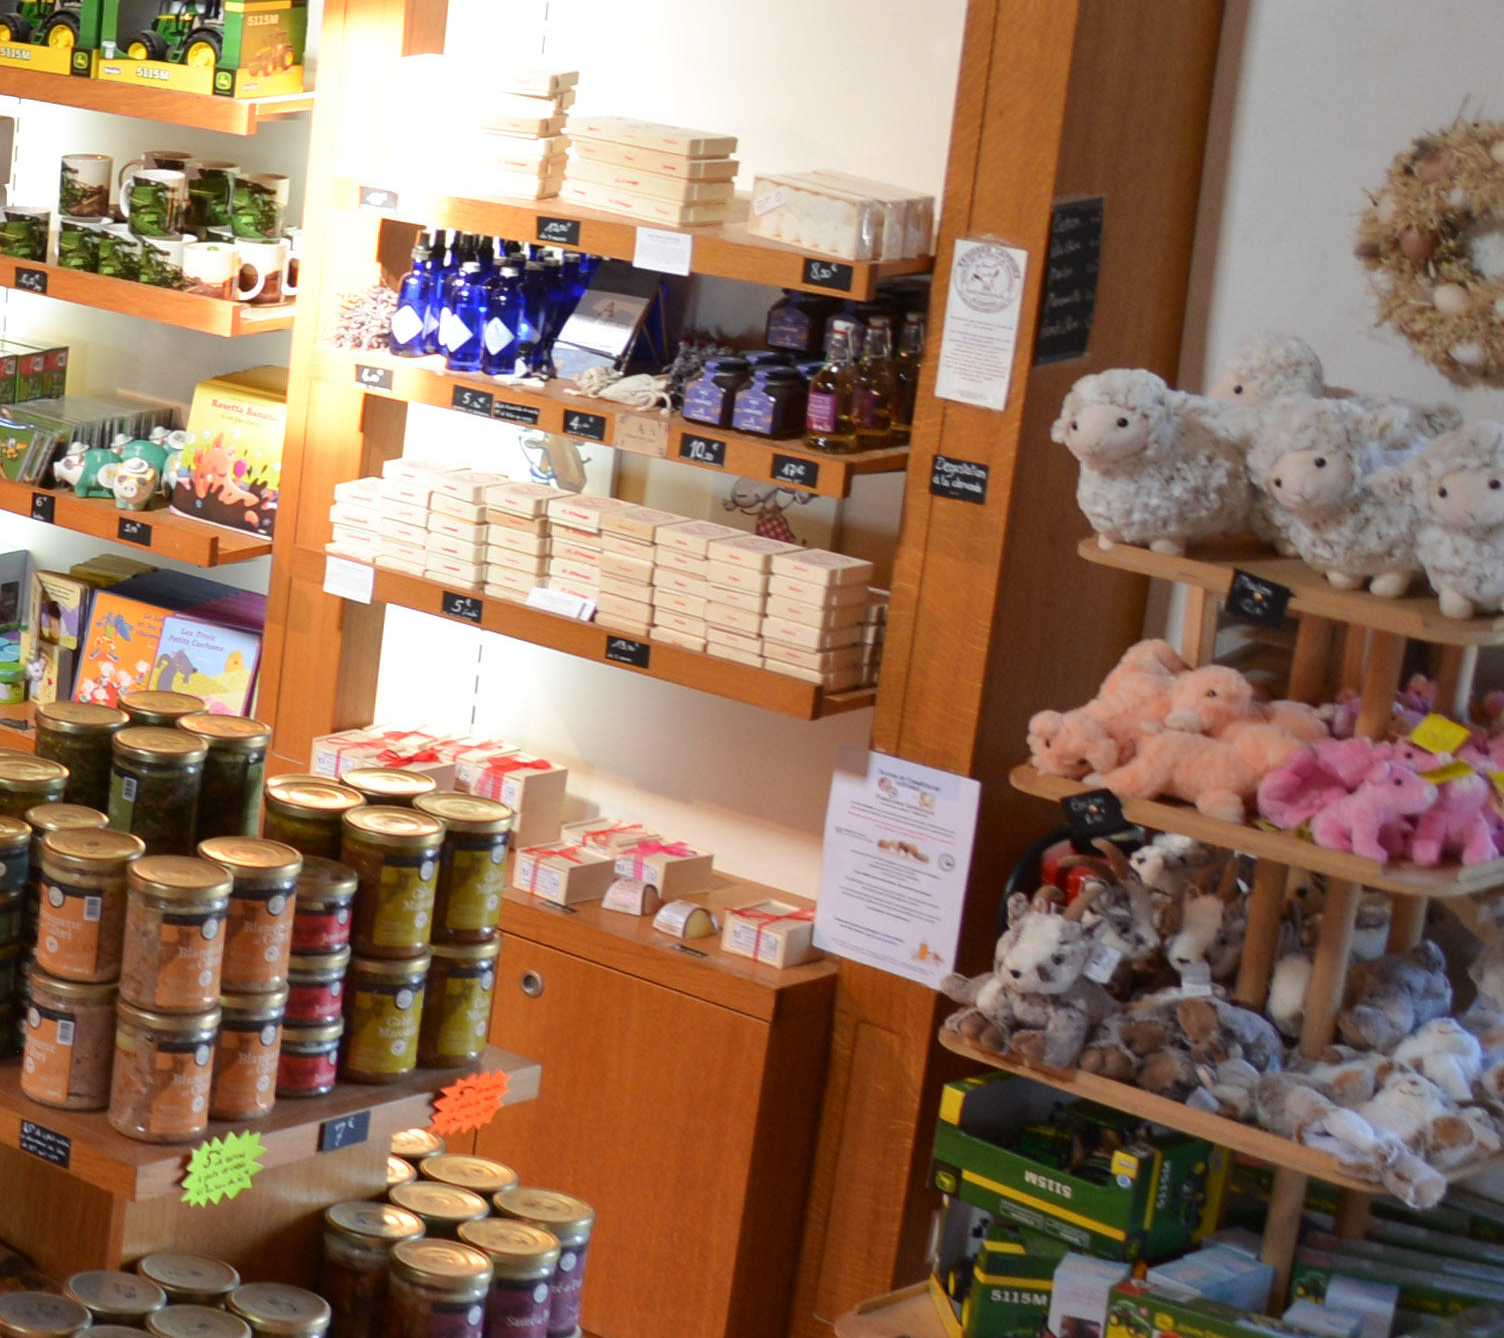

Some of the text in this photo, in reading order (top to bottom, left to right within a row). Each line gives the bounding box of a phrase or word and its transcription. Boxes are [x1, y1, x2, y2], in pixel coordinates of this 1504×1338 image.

[0, 47, 31, 61] 5115M
[136, 66, 169, 81] 5115M
[180, 627, 217, 641] Les Trois
[168, 634, 190, 645] Petits
[191, 639, 225, 652] Cochons
[1024, 1168, 1073, 1200] 5115M
[990, 1287, 1048, 1308] 5115M
[507, 1316, 533, 1328] Sauté
